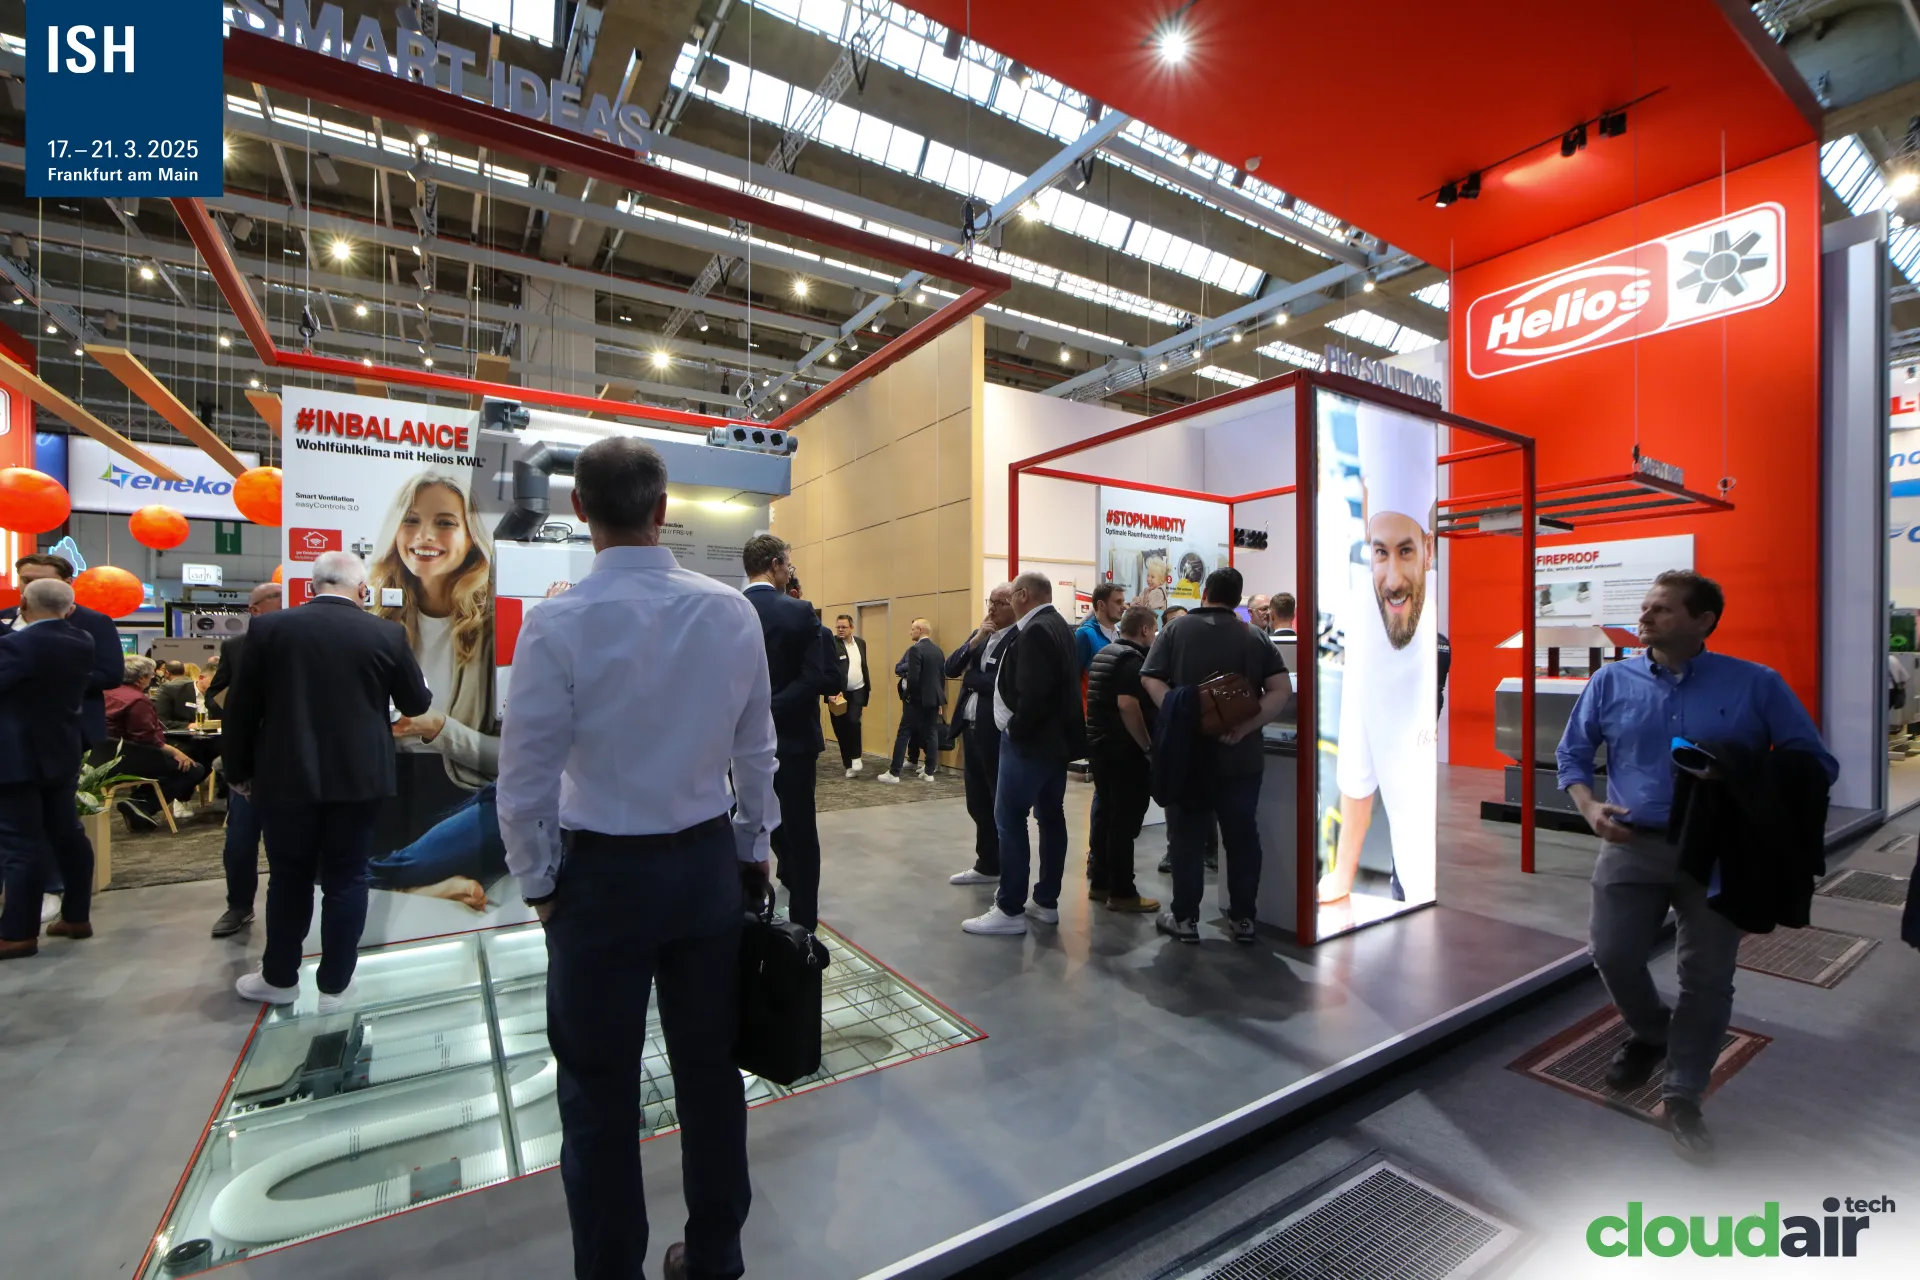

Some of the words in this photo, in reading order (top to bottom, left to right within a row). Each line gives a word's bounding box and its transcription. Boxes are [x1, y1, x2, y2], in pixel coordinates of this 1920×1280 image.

[231, 0, 476, 98] SMART
[491, 59, 652, 153] IDEAS
[1485, 278, 1652, 351] Helios
[1324, 343, 1360, 379] PRO
[1360, 356, 1442, 404] SOLUTIONS
[295, 407, 469, 452] #INBALANCE
[295, 438, 391, 459] Wohlfühlklima
[393, 449, 414, 461] mit
[416, 451, 454, 465] Helios
[130, 474, 232, 496] eneko
[295, 492, 317, 501] Smart
[318, 494, 355, 503] Ventilation
[295, 501, 346, 511] easyControls
[1105, 527, 1127, 537] Optimale
[1106, 509, 1186, 533] #STOPHUMIDITY
[1535, 550, 1599, 566] FIREPROOF
